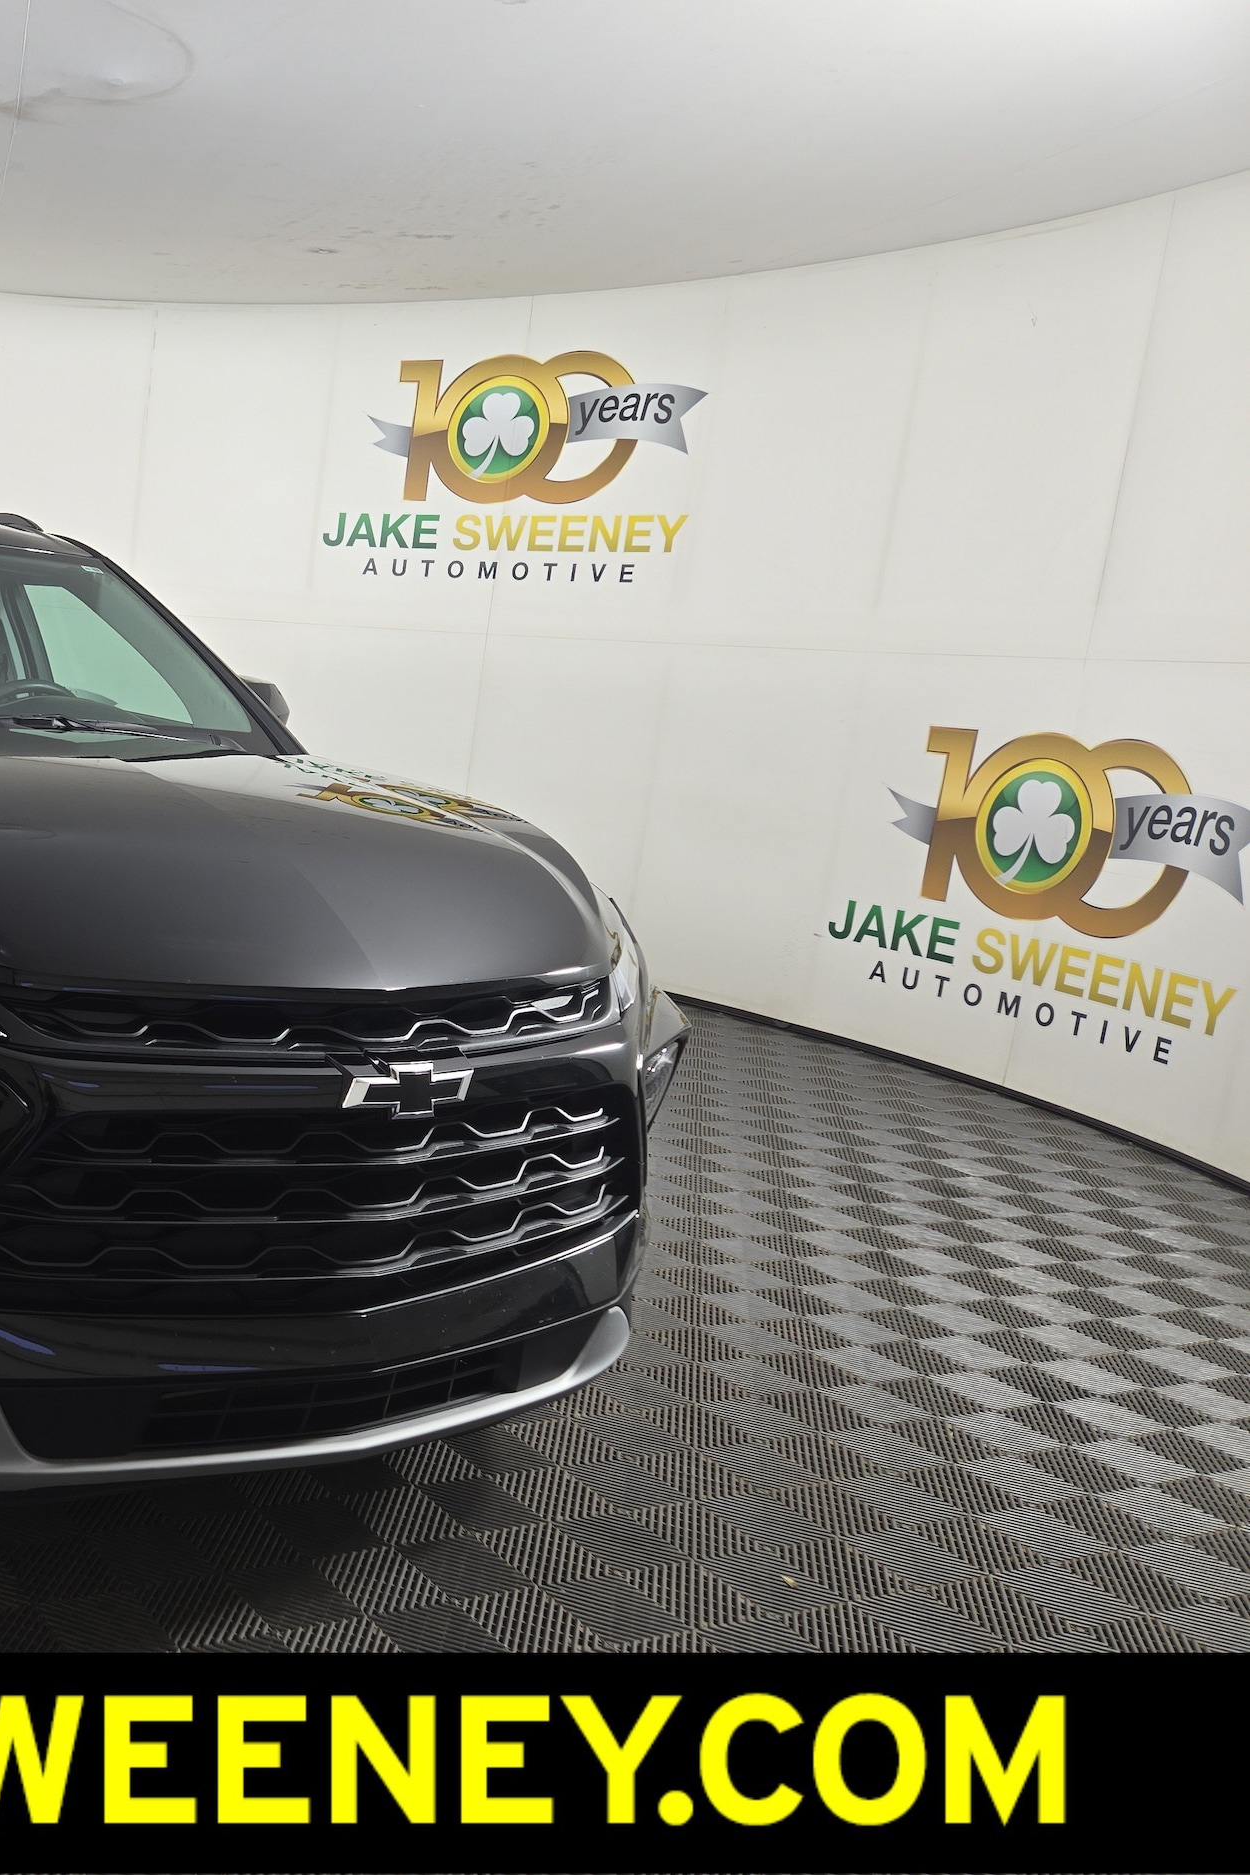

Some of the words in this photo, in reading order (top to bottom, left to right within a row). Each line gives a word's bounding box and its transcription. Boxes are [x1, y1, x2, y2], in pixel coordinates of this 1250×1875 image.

[575, 392, 675, 436] years
[322, 512, 440, 550] JAKE
[452, 514, 690, 553] SWEENEY
[362, 558, 635, 583] AUTOMOTIVE
[1119, 804, 1236, 856] years
[828, 899, 961, 965] JAKE
[972, 928, 1238, 1037] SWEENEY
[868, 960, 1172, 1065] AUTOMOTIVE
